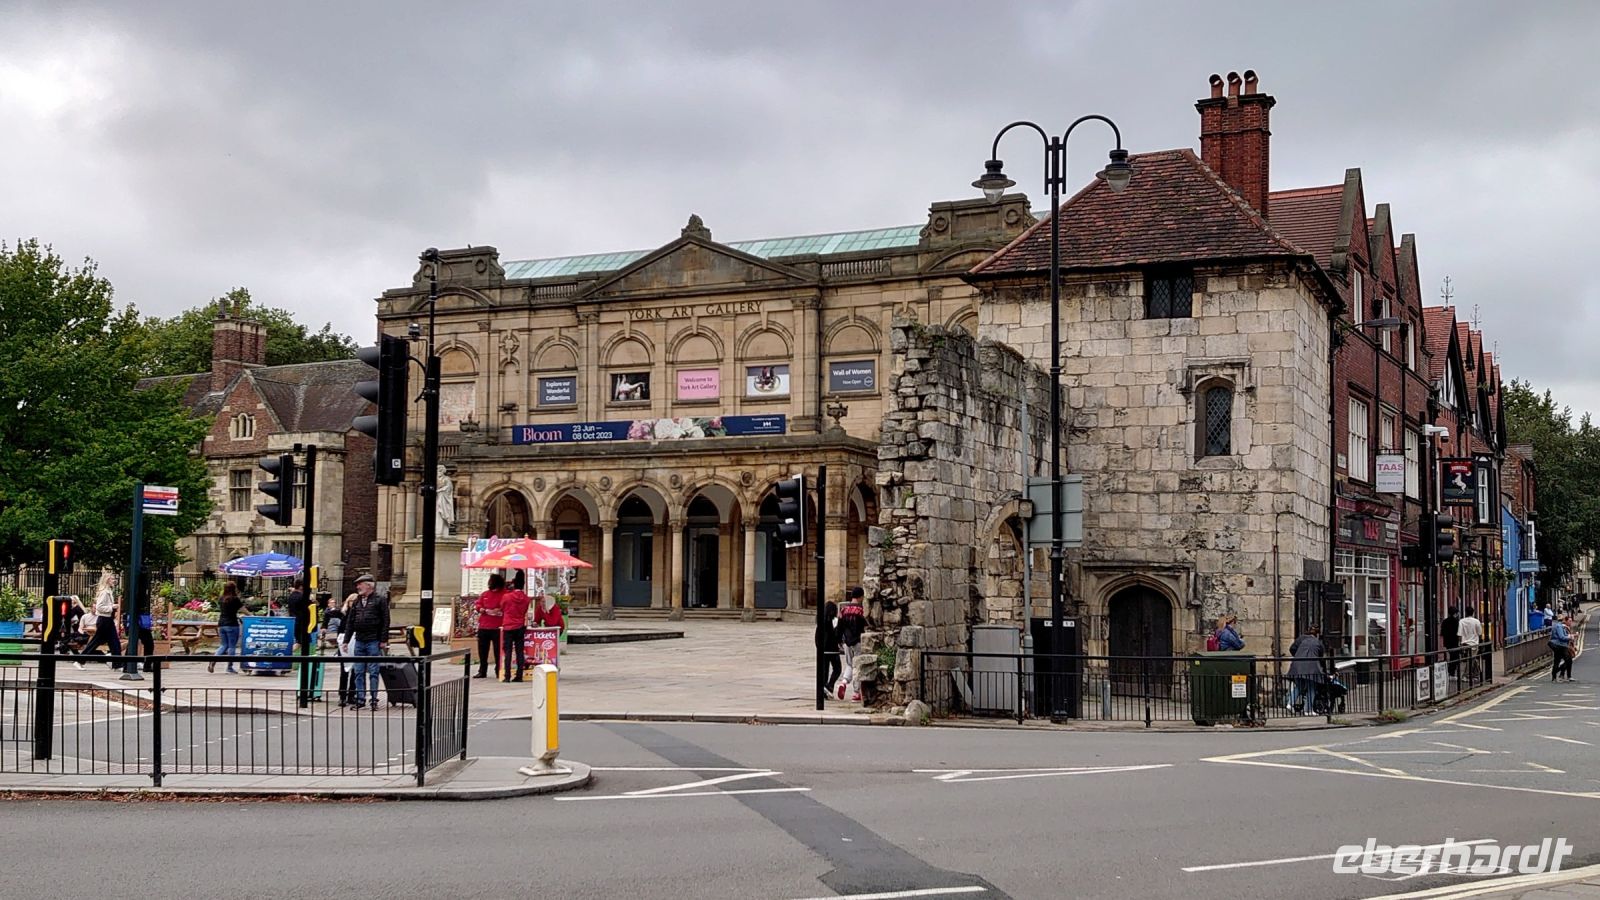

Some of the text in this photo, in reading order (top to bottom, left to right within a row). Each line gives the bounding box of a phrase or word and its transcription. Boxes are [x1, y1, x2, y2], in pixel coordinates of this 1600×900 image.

[627, 300, 762, 320] YORK ART GALLERY
[572, 425, 582, 433] 23
[522, 427, 563, 442] Bloom
[572, 432, 582, 440] 08
[595, 431, 613, 439] 2023
[1377, 463, 1404, 471] TAAS
[533, 631, 556, 639] tickets
